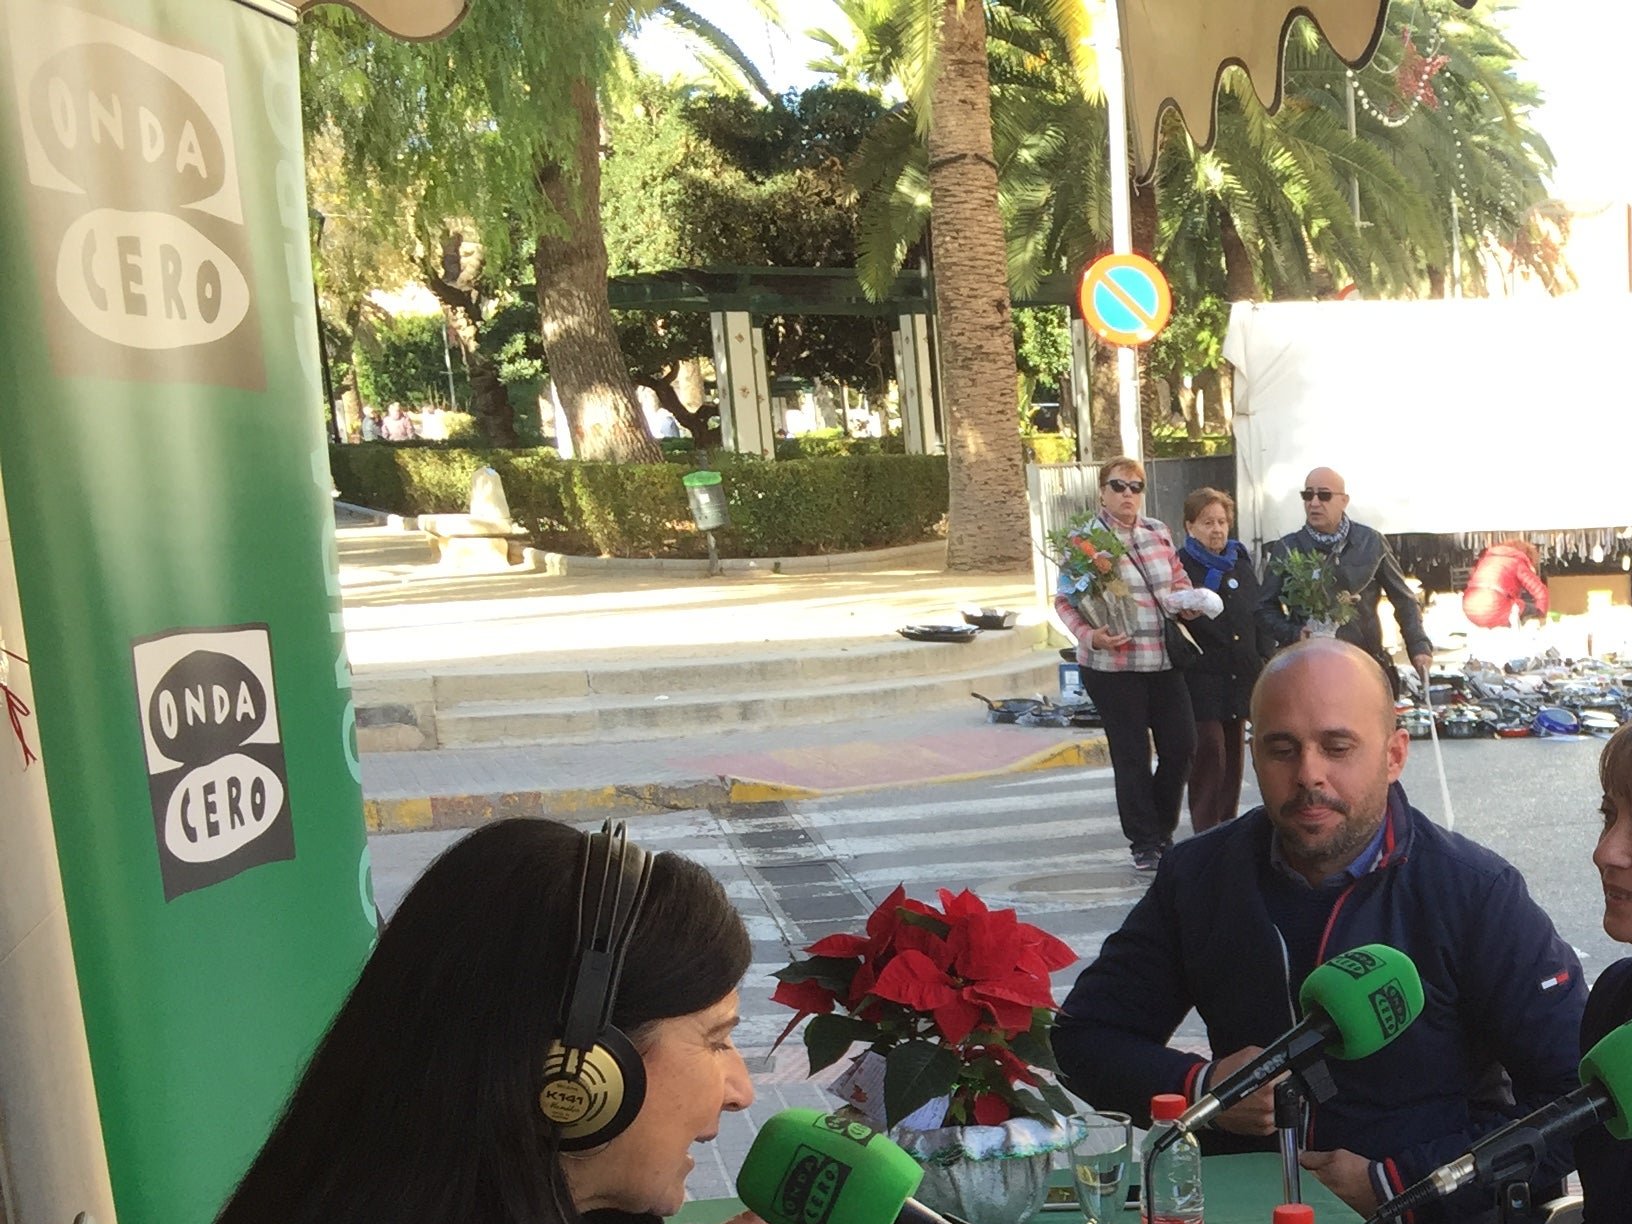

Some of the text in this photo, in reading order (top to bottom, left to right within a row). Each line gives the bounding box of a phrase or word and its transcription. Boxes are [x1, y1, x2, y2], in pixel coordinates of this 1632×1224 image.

[48, 76, 208, 179] ONDA
[81, 228, 222, 325] CERO
[158, 680, 257, 740] ONDA
[180, 775, 267, 844] CERO
[1378, 998, 1396, 1031] CERO
[546, 1090, 584, 1105] K141
[784, 1159, 816, 1211] ONDA
[804, 1169, 836, 1219] CERO
